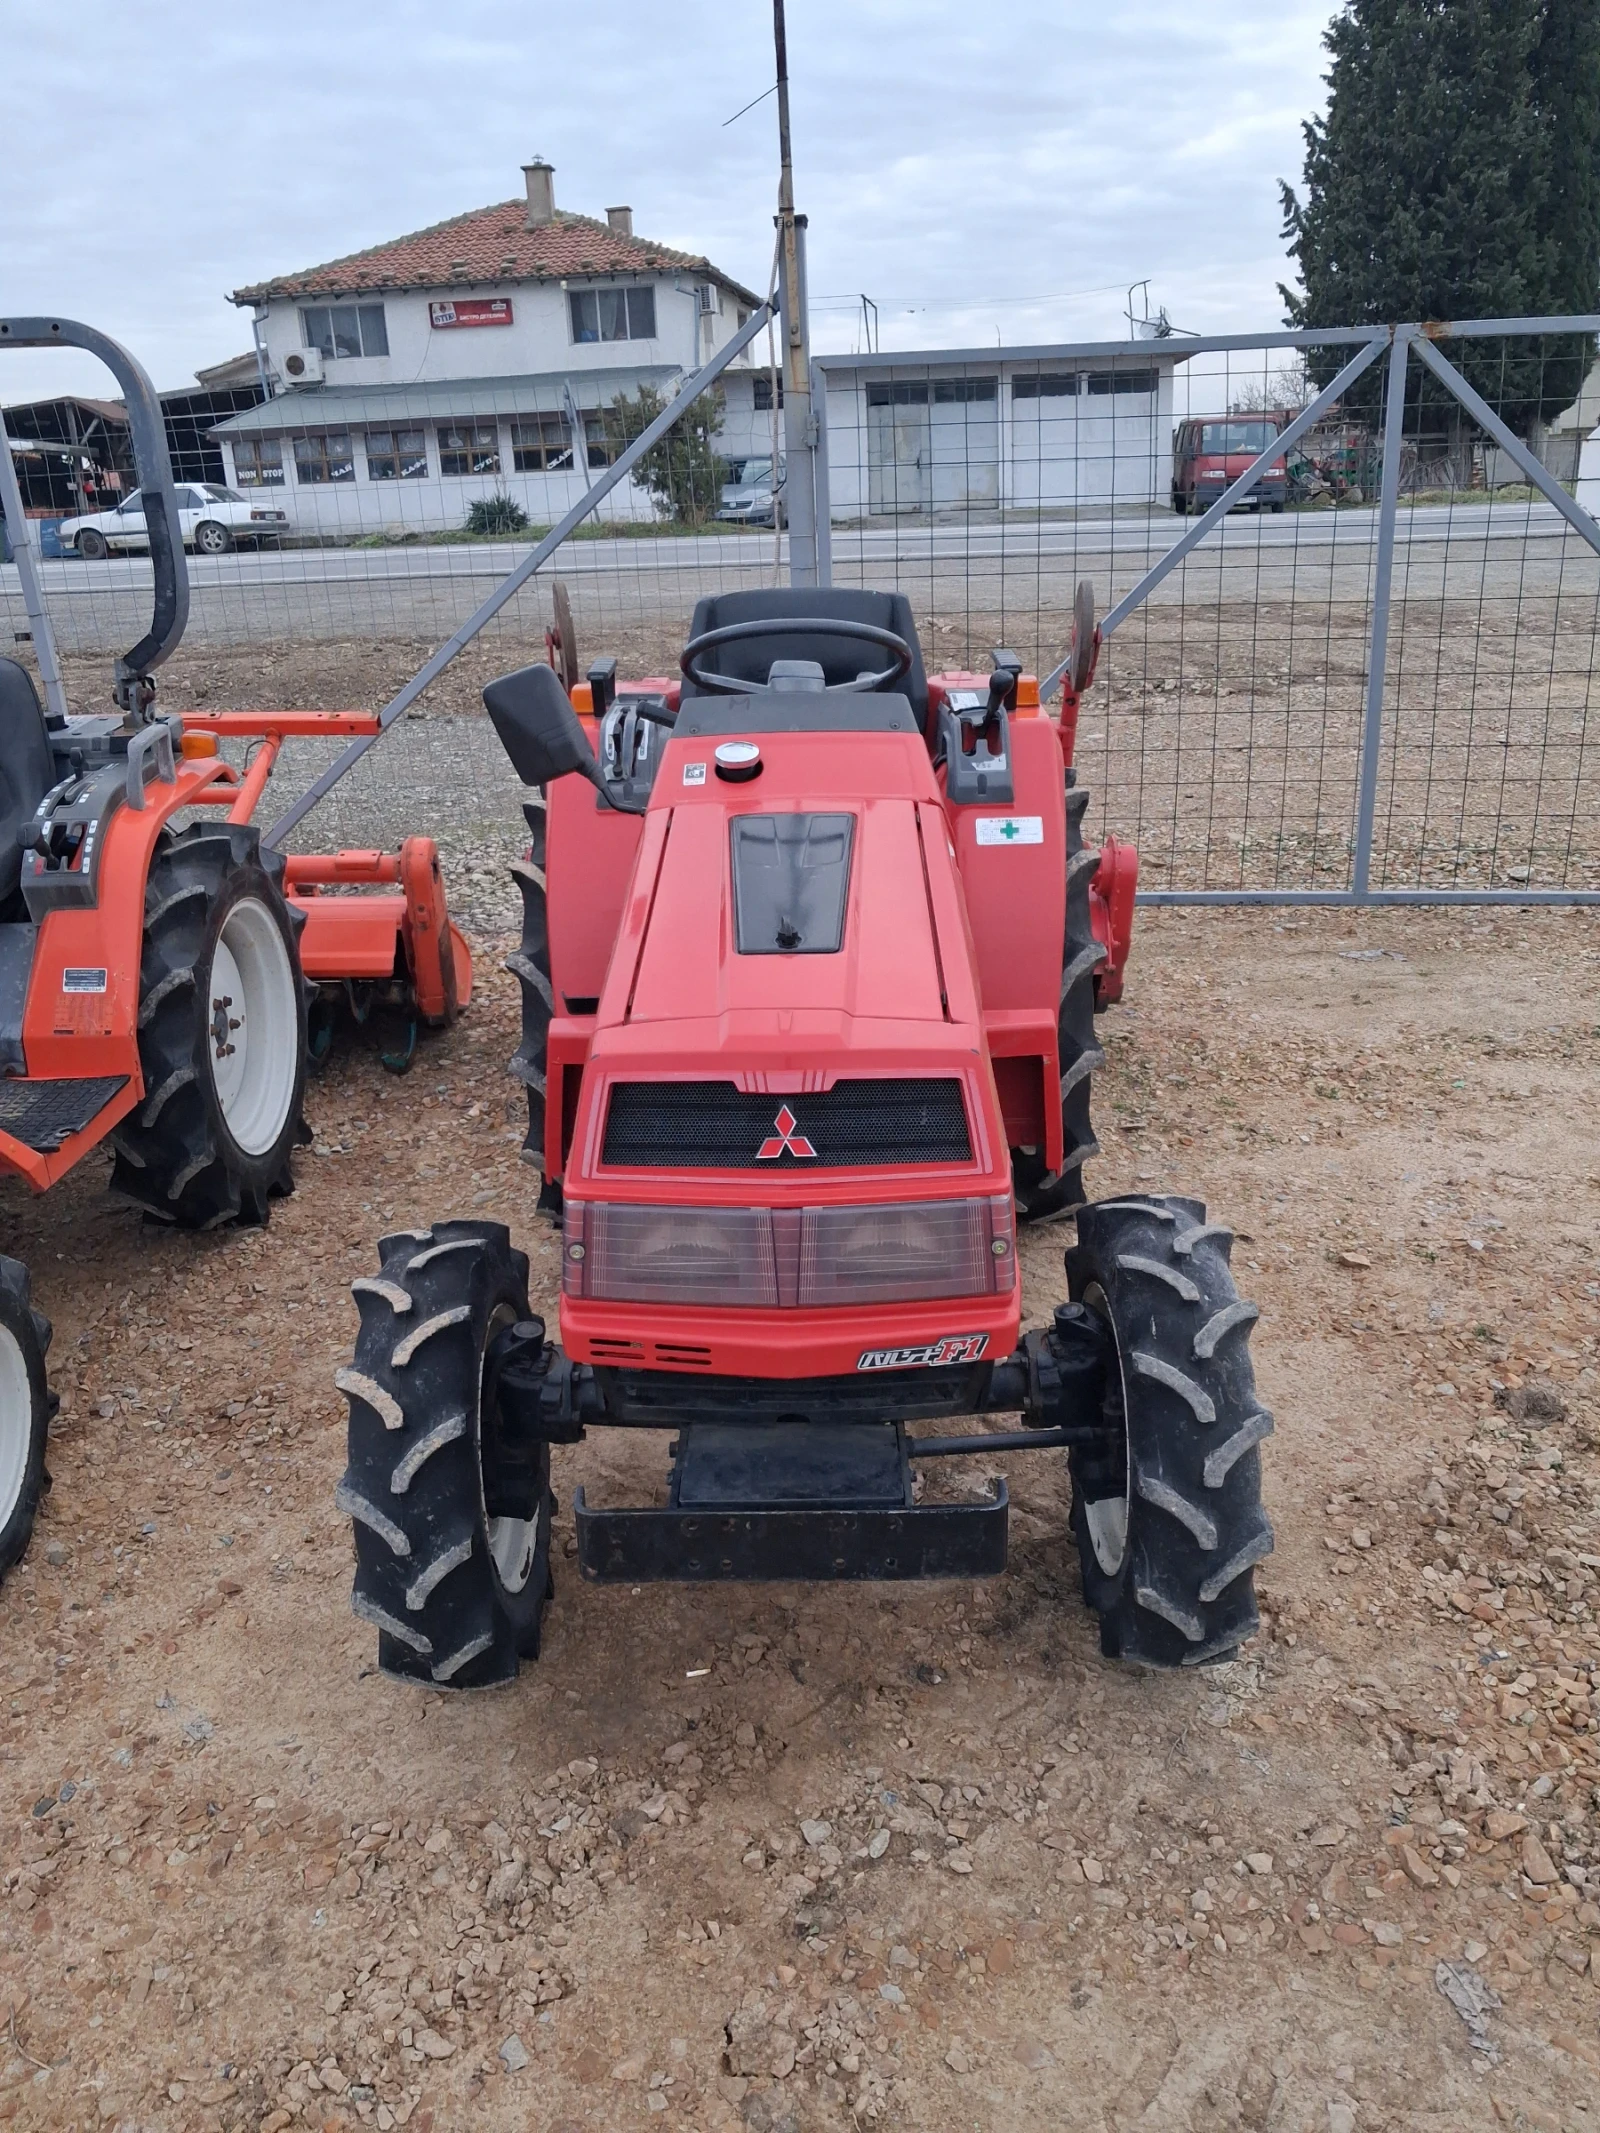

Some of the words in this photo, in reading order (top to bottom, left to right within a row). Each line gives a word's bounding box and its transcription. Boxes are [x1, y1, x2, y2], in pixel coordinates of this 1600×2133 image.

[331, 461, 352, 477] ЧАЙ
[401, 457, 427, 476] КАФЕ
[473, 454, 499, 471] СУПА
[238, 470, 257, 480] NON
[262, 469, 284, 478] STOP
